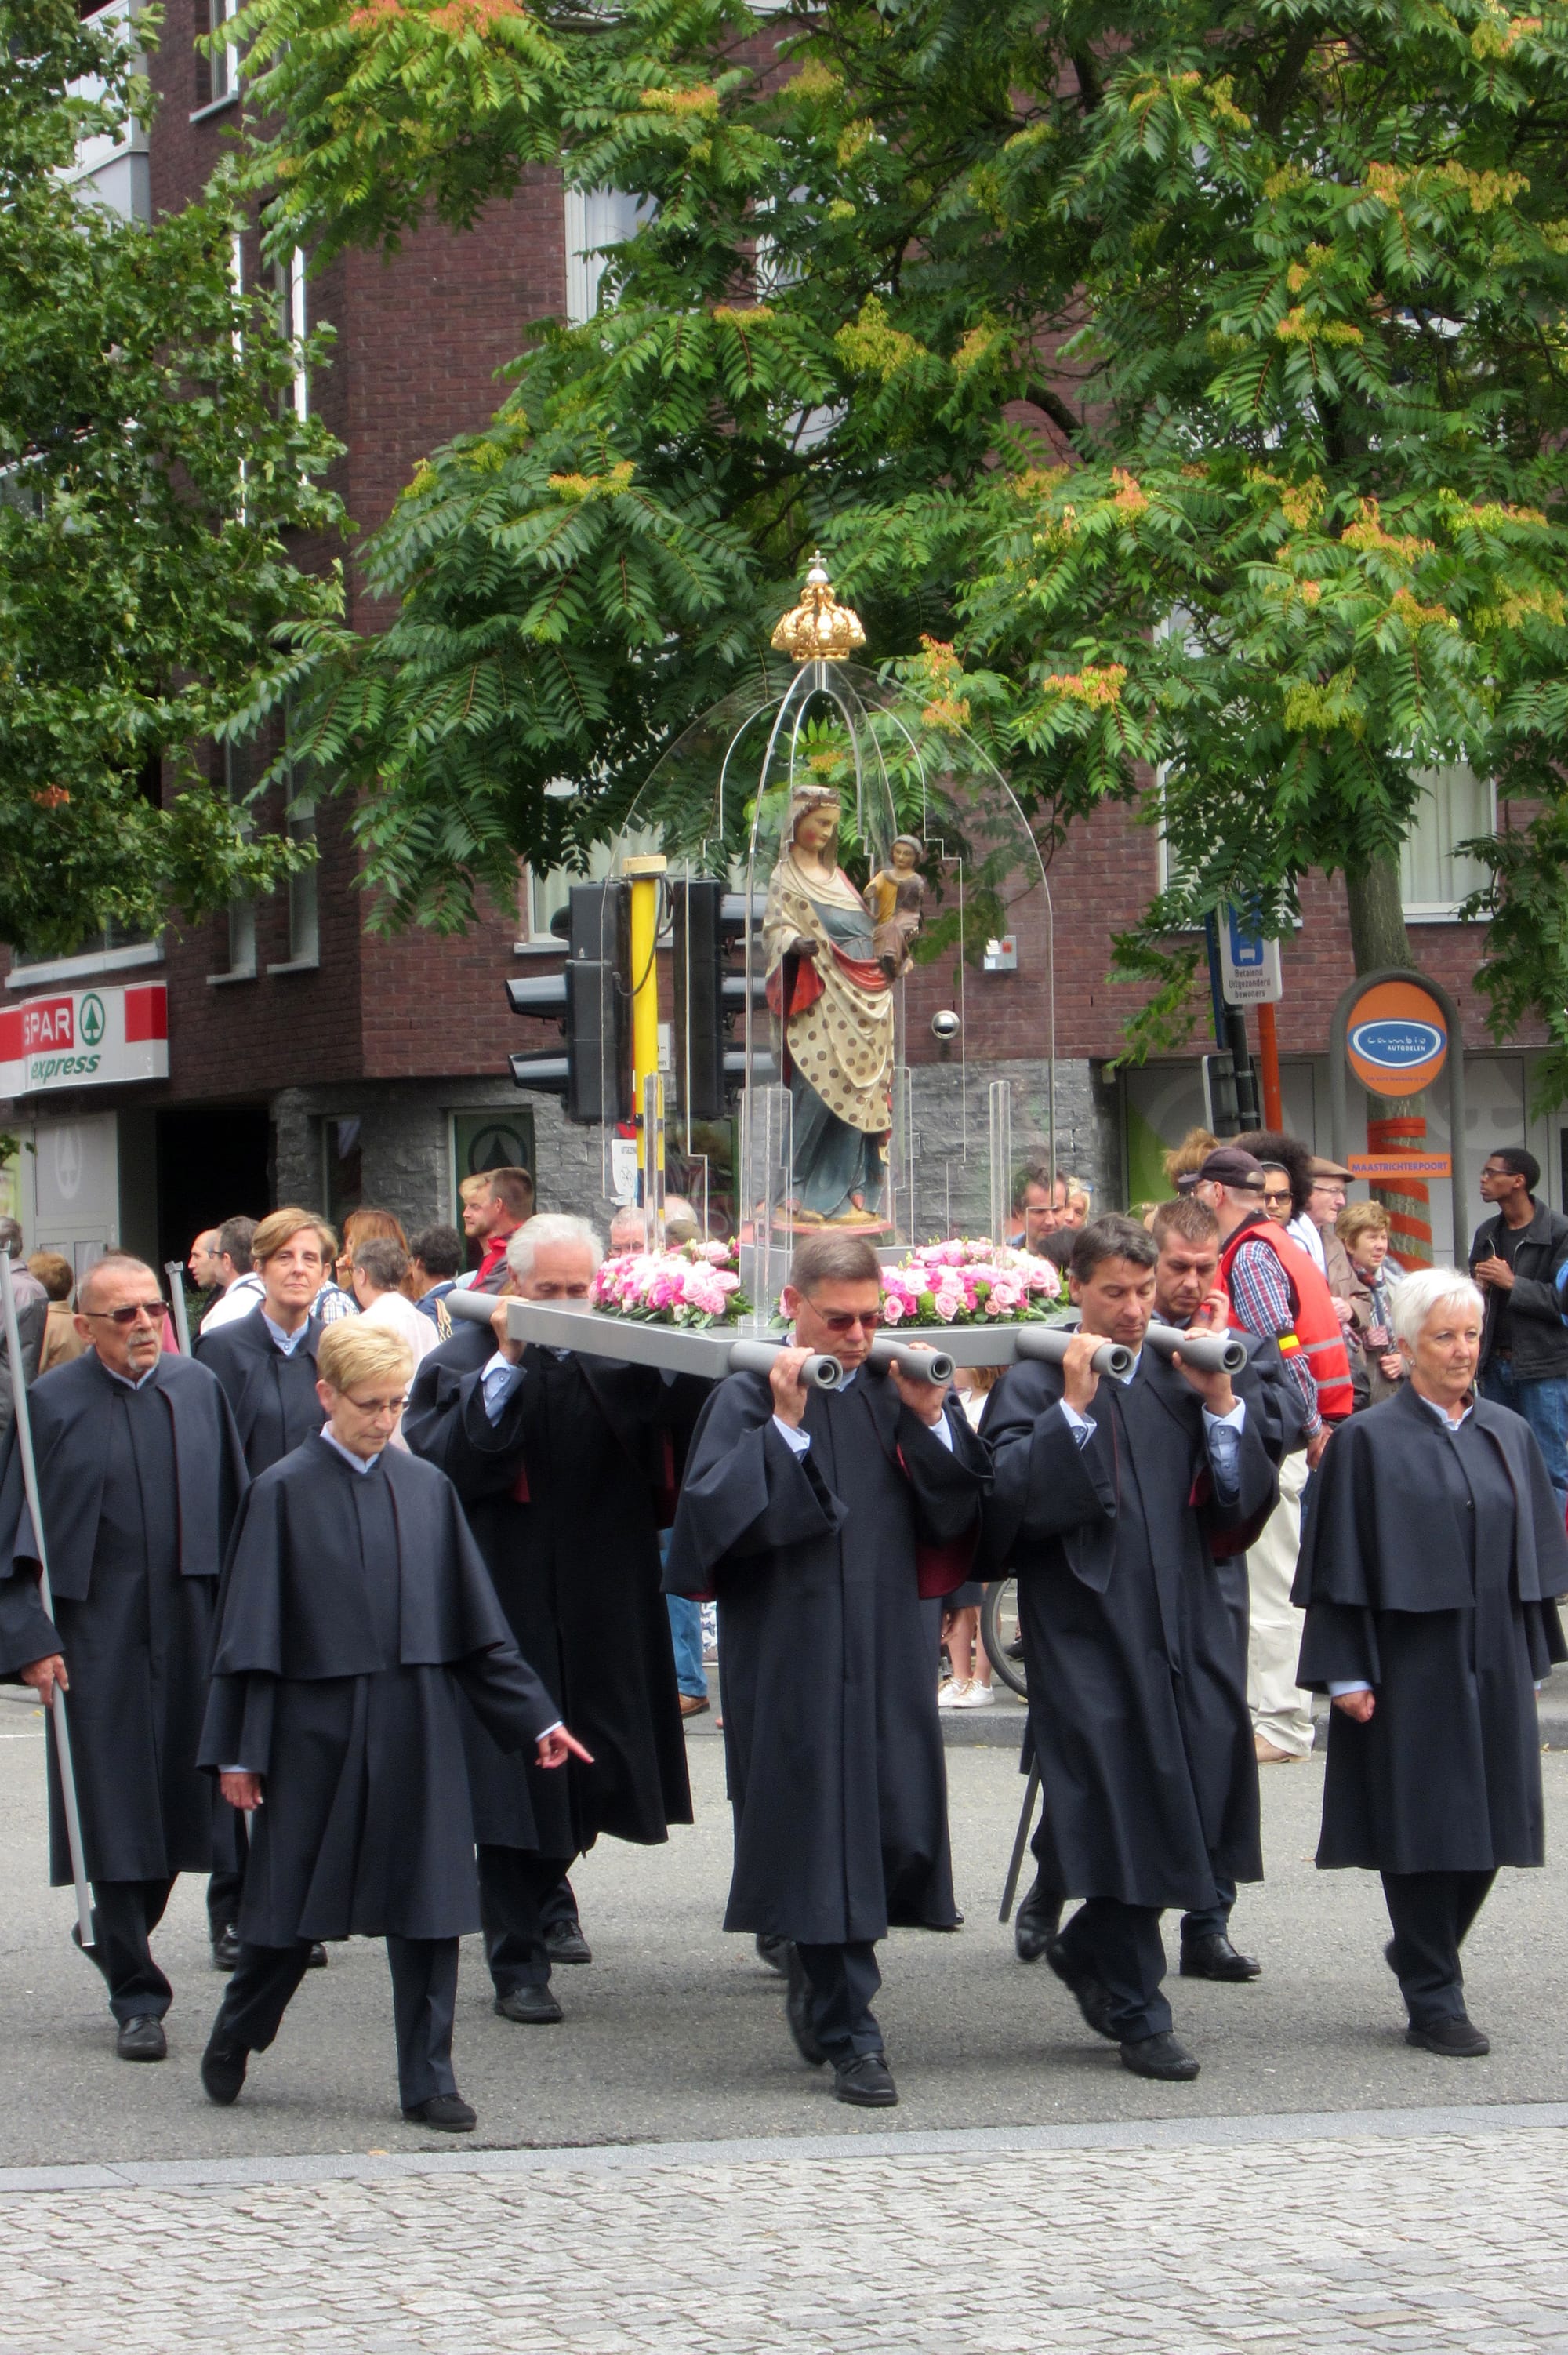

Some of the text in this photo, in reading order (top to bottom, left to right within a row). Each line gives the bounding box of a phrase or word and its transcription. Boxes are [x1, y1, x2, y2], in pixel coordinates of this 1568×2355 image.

[1234, 969, 1263, 977] Betalend
[1229, 979, 1271, 990] Uitgezonderd
[1234, 990, 1265, 998] bewoners
[24, 1007, 71, 1045] SPAR
[31, 1054, 101, 1084] express
[1352, 1161, 1448, 1172] MAASTRICHTERPOORT
